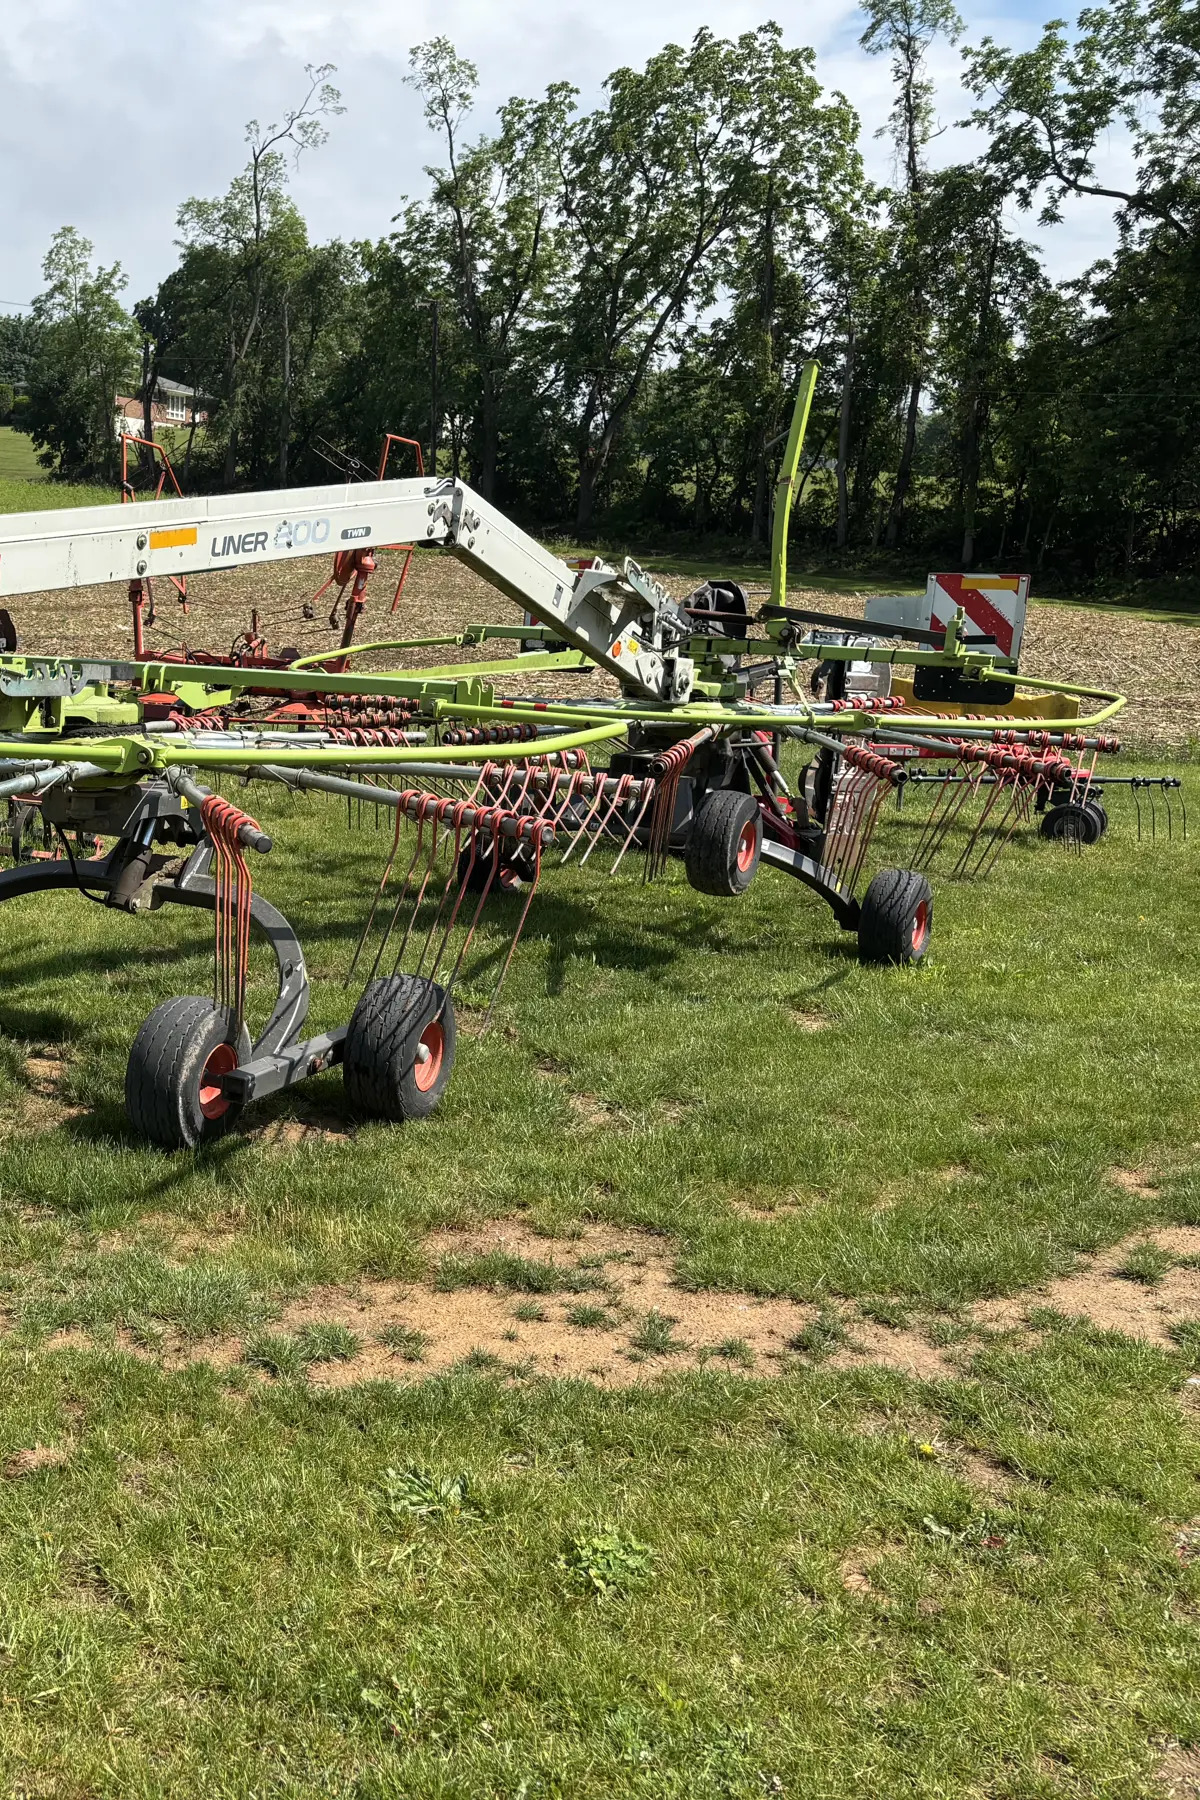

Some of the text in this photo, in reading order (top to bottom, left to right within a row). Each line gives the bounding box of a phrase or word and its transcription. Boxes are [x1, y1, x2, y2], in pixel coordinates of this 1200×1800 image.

[211, 518, 331, 557] LINER 800
[347, 528, 366, 538] TWIN
